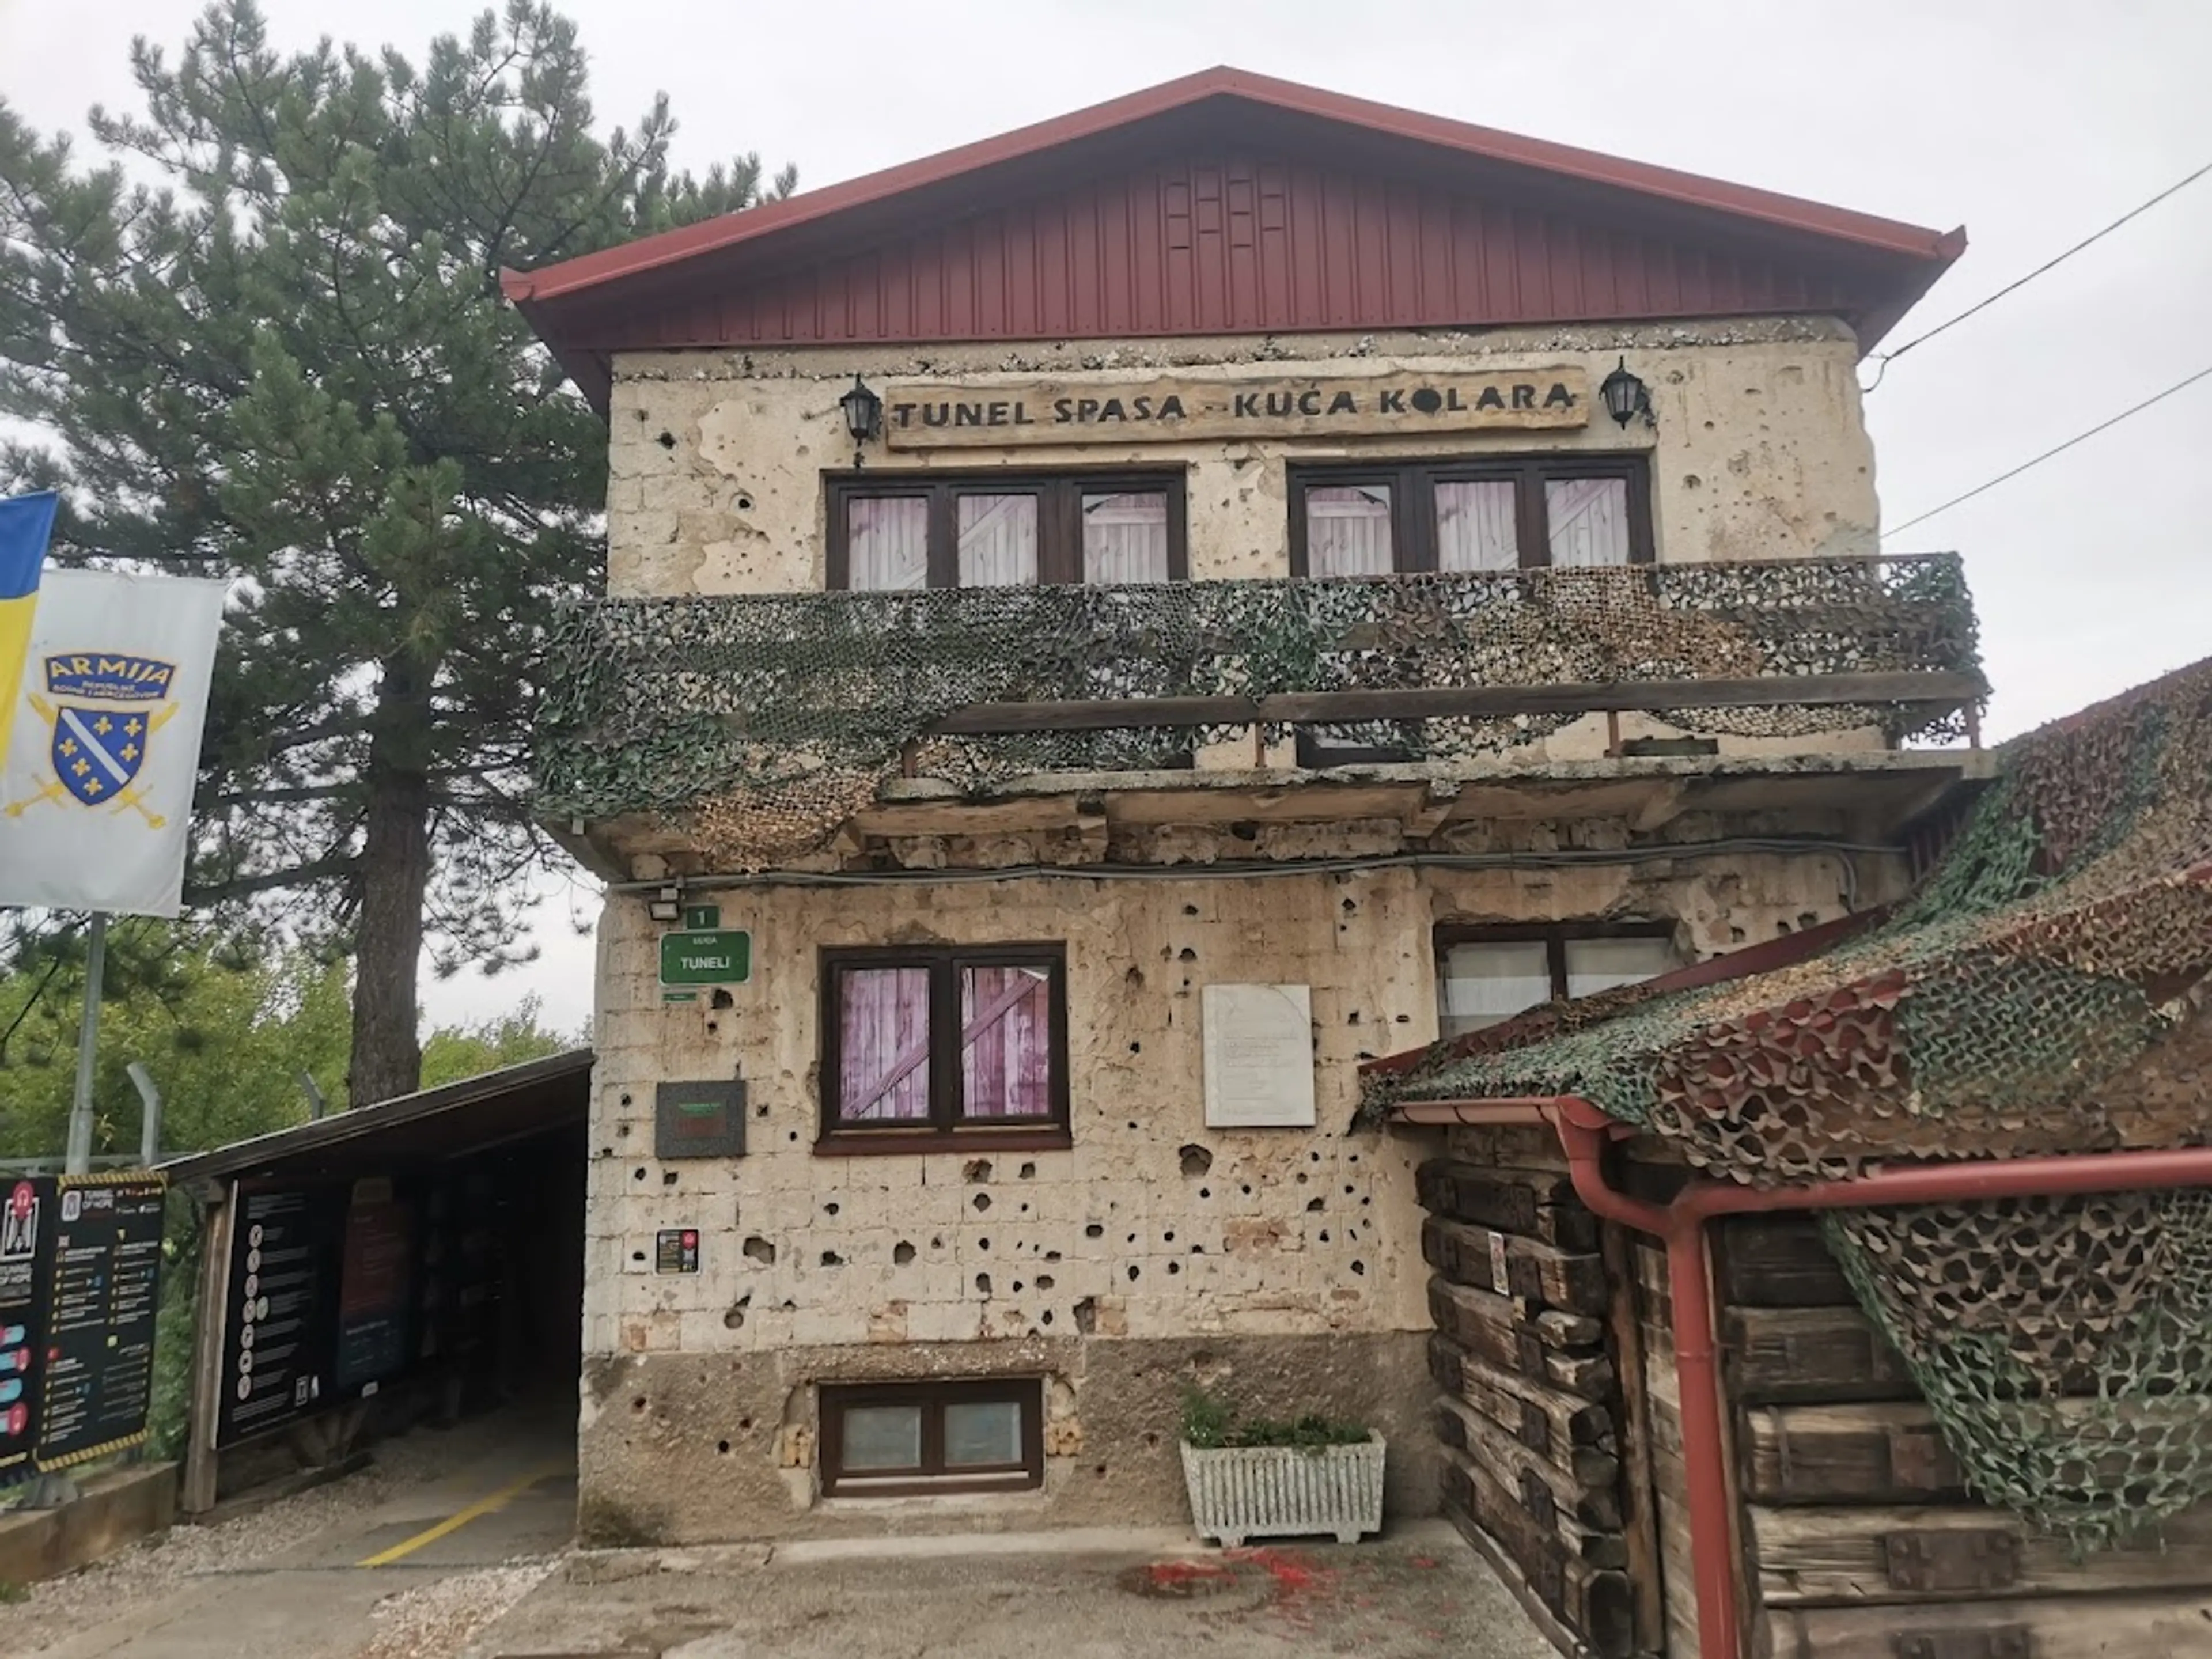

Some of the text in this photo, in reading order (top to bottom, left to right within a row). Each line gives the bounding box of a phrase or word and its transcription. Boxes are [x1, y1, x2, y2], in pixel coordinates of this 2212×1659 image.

[893, 402, 1035, 428] TUNEL
[1052, 395, 1187, 423] SPASA
[1235, 383, 1358, 418] KUĆA
[1380, 382, 1576, 414] KOLARA
[50, 657, 169, 684] ARMIJA
[698, 910, 706, 925] 1
[680, 956, 730, 970] TUNELI
